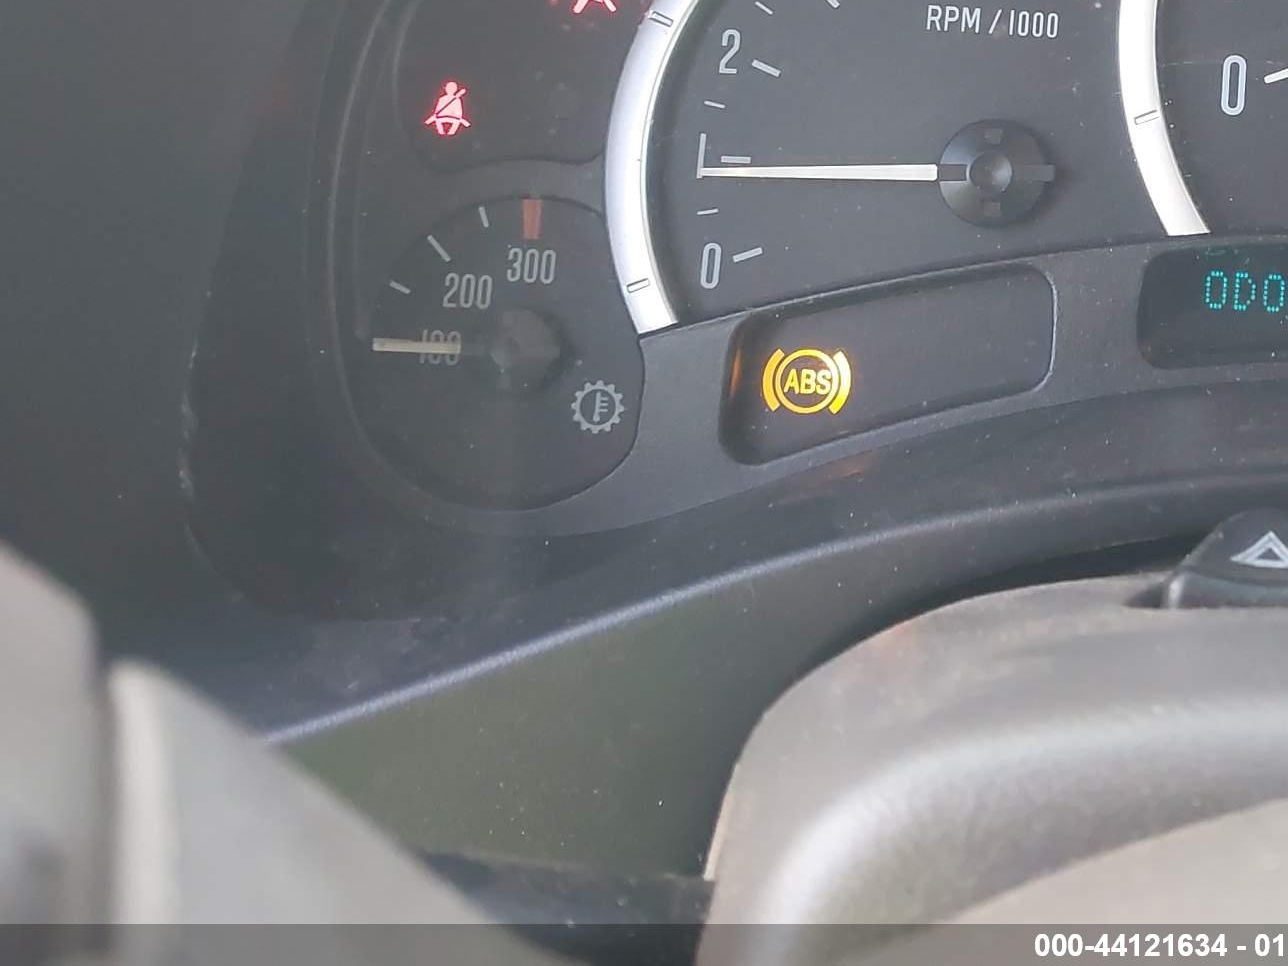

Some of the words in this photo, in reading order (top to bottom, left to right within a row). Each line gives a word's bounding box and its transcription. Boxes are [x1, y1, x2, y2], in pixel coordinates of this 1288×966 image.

[925, 4, 981, 34] RPM
[1008, 10, 1059, 38] 1000
[719, 29, 739, 75] 2
[1221, 55, 1247, 115] 0
[506, 248, 556, 284] 300
[701, 242, 721, 289] 0
[442, 272, 493, 309] 200
[783, 368, 832, 395] ABS
